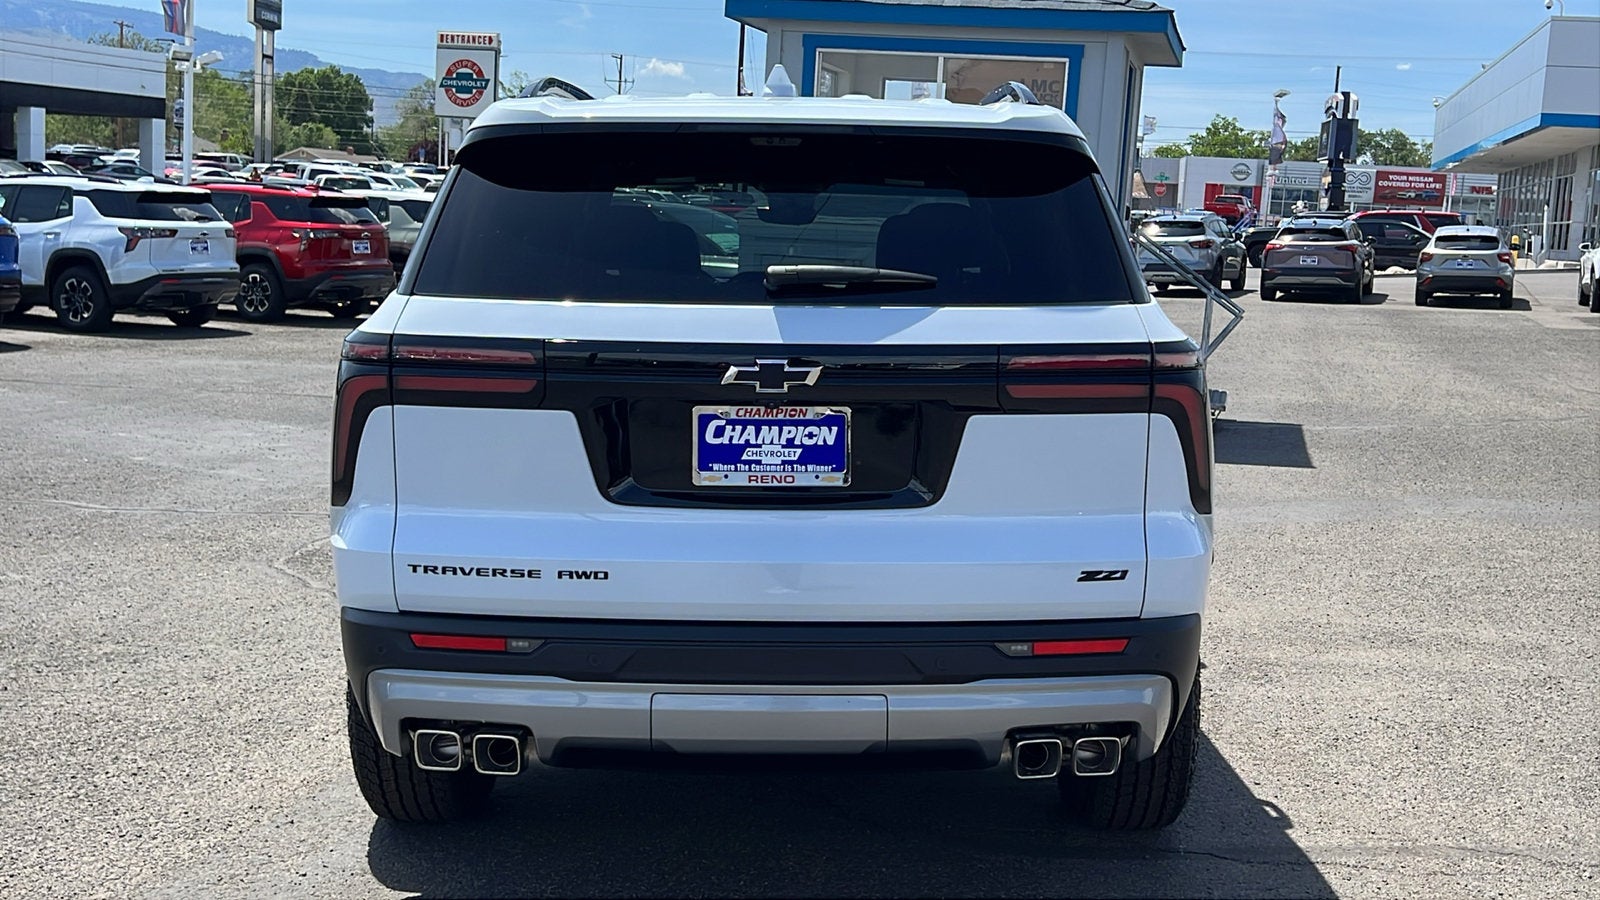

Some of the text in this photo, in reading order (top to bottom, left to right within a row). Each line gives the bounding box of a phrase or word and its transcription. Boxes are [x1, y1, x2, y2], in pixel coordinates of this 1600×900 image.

[445, 34, 487, 45] ENTRANCE
[450, 60, 479, 73] SUPER
[442, 79, 486, 88] CHEVROLET
[447, 90, 482, 106] SERVICE
[1275, 175, 1309, 185] United
[1408, 175, 1434, 183] NISSAN
[1378, 180, 1410, 188] COVERED
[1426, 182, 1442, 190] LIFE!
[735, 407, 808, 418] CHAMPION
[746, 449, 797, 458] CHEVROLET
[737, 463, 749, 472] The
[751, 463, 784, 472] Customer
[794, 463, 805, 472] The
[748, 474, 795, 484] RENO
[407, 563, 609, 580] TRAVERSE AWD
